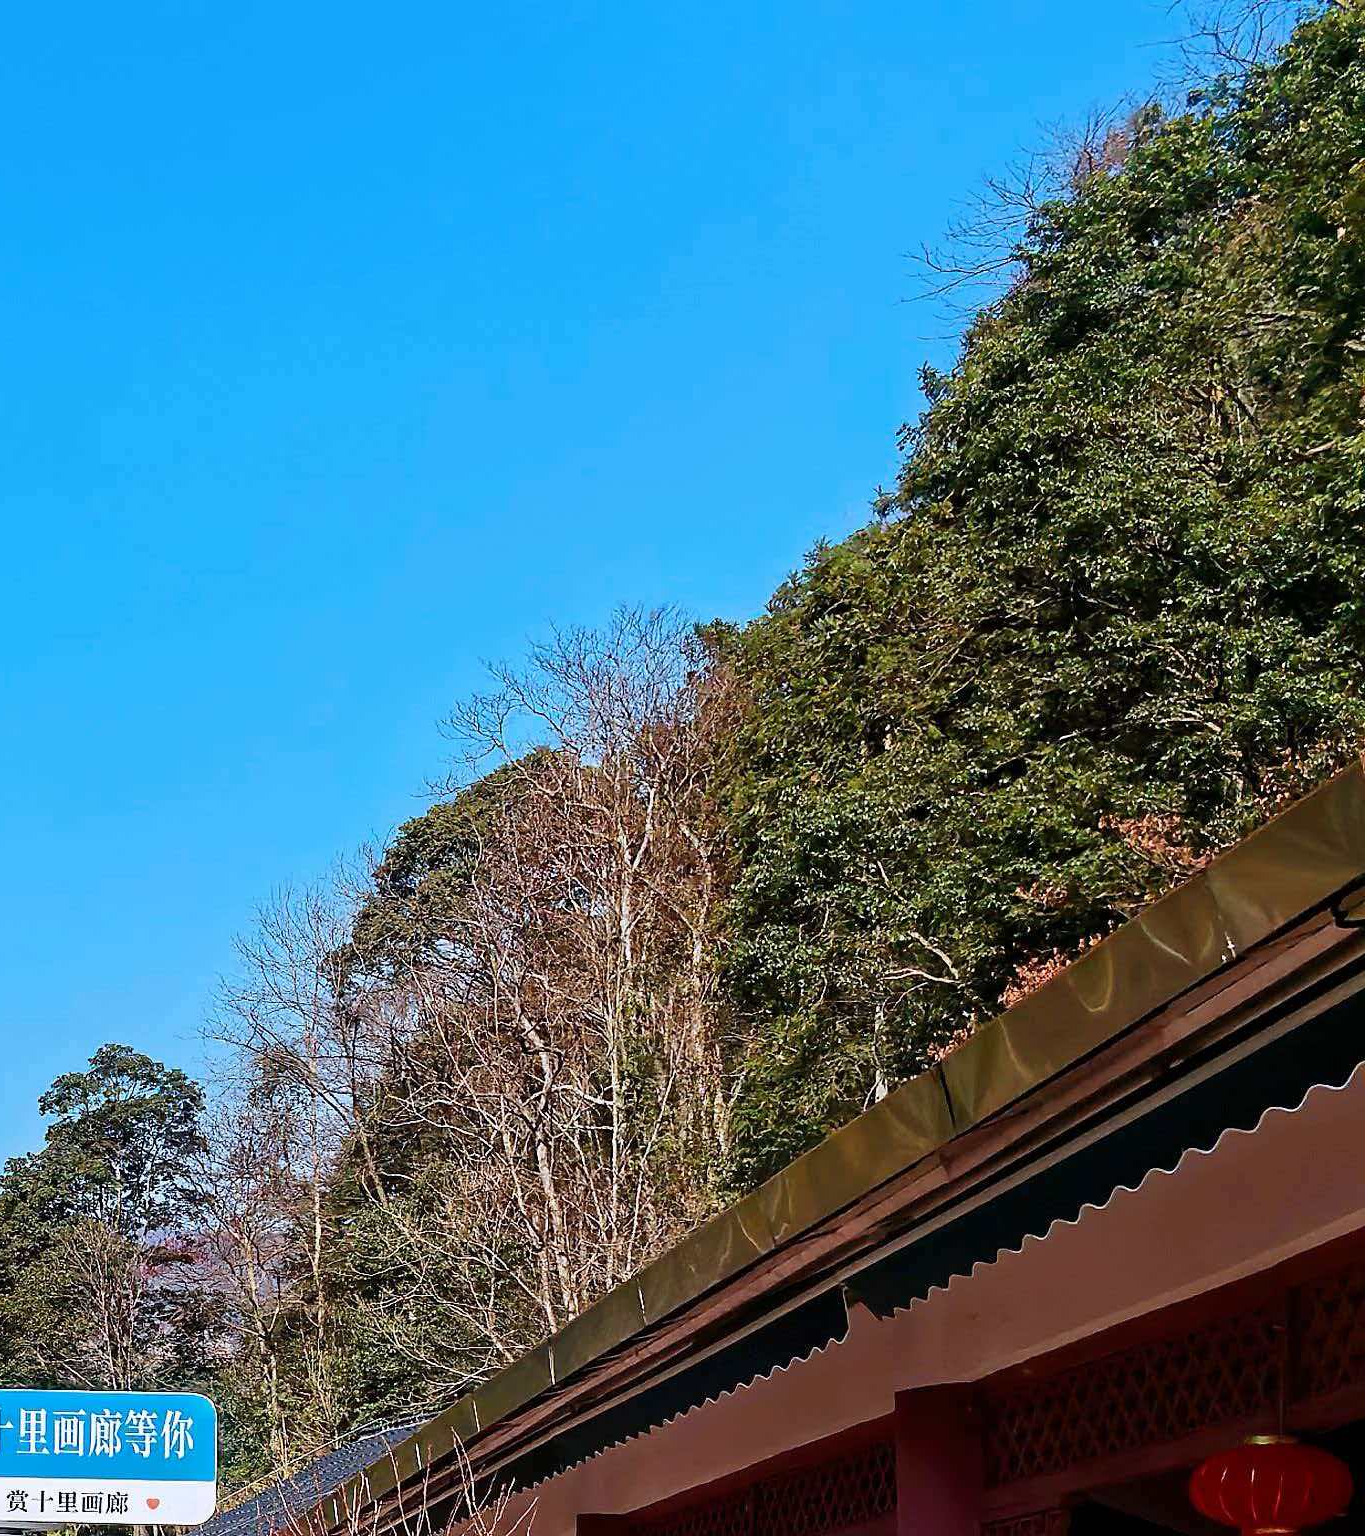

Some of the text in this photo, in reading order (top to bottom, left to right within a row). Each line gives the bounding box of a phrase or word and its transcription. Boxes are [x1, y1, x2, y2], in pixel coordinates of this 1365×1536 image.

[5, 1488, 130, 1516] 赏十里画廊
